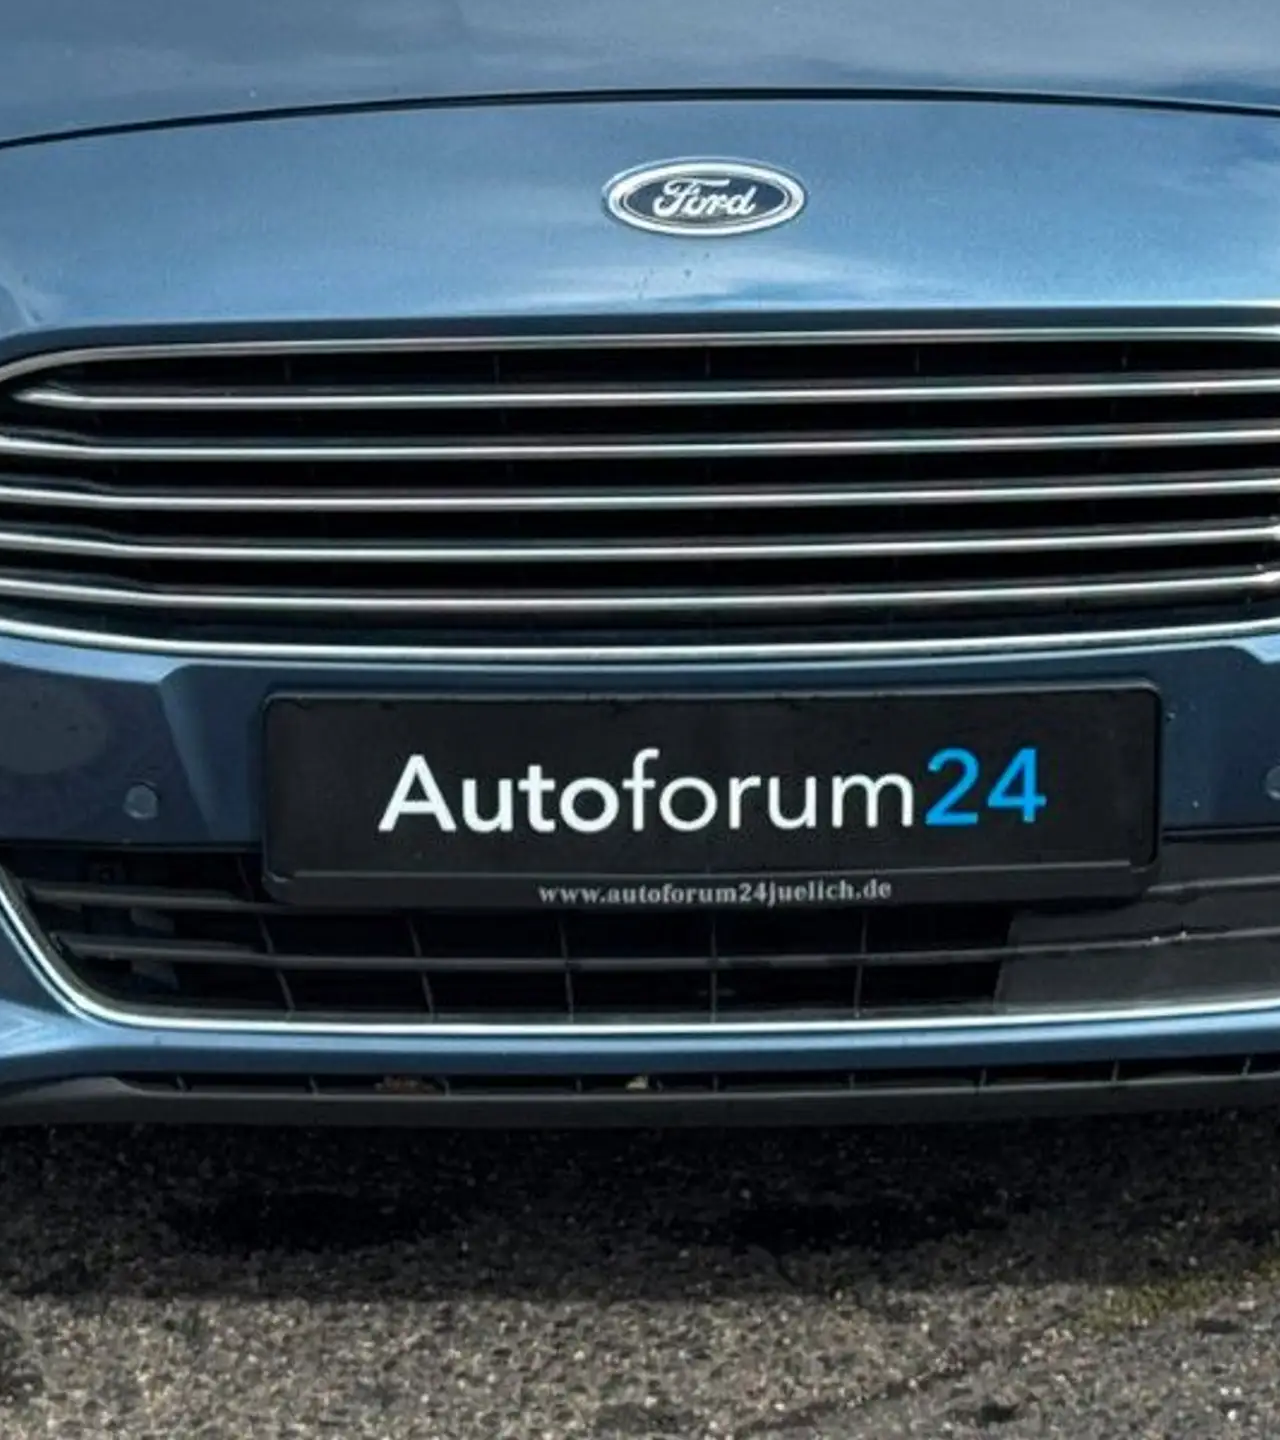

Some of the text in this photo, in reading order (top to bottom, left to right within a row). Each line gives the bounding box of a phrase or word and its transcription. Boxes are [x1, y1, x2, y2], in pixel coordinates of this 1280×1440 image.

[652, 178, 757, 217] Ford
[378, 747, 1047, 833] Autoforum24
[538, 879, 892, 907] www.autoforum24juelich.de
